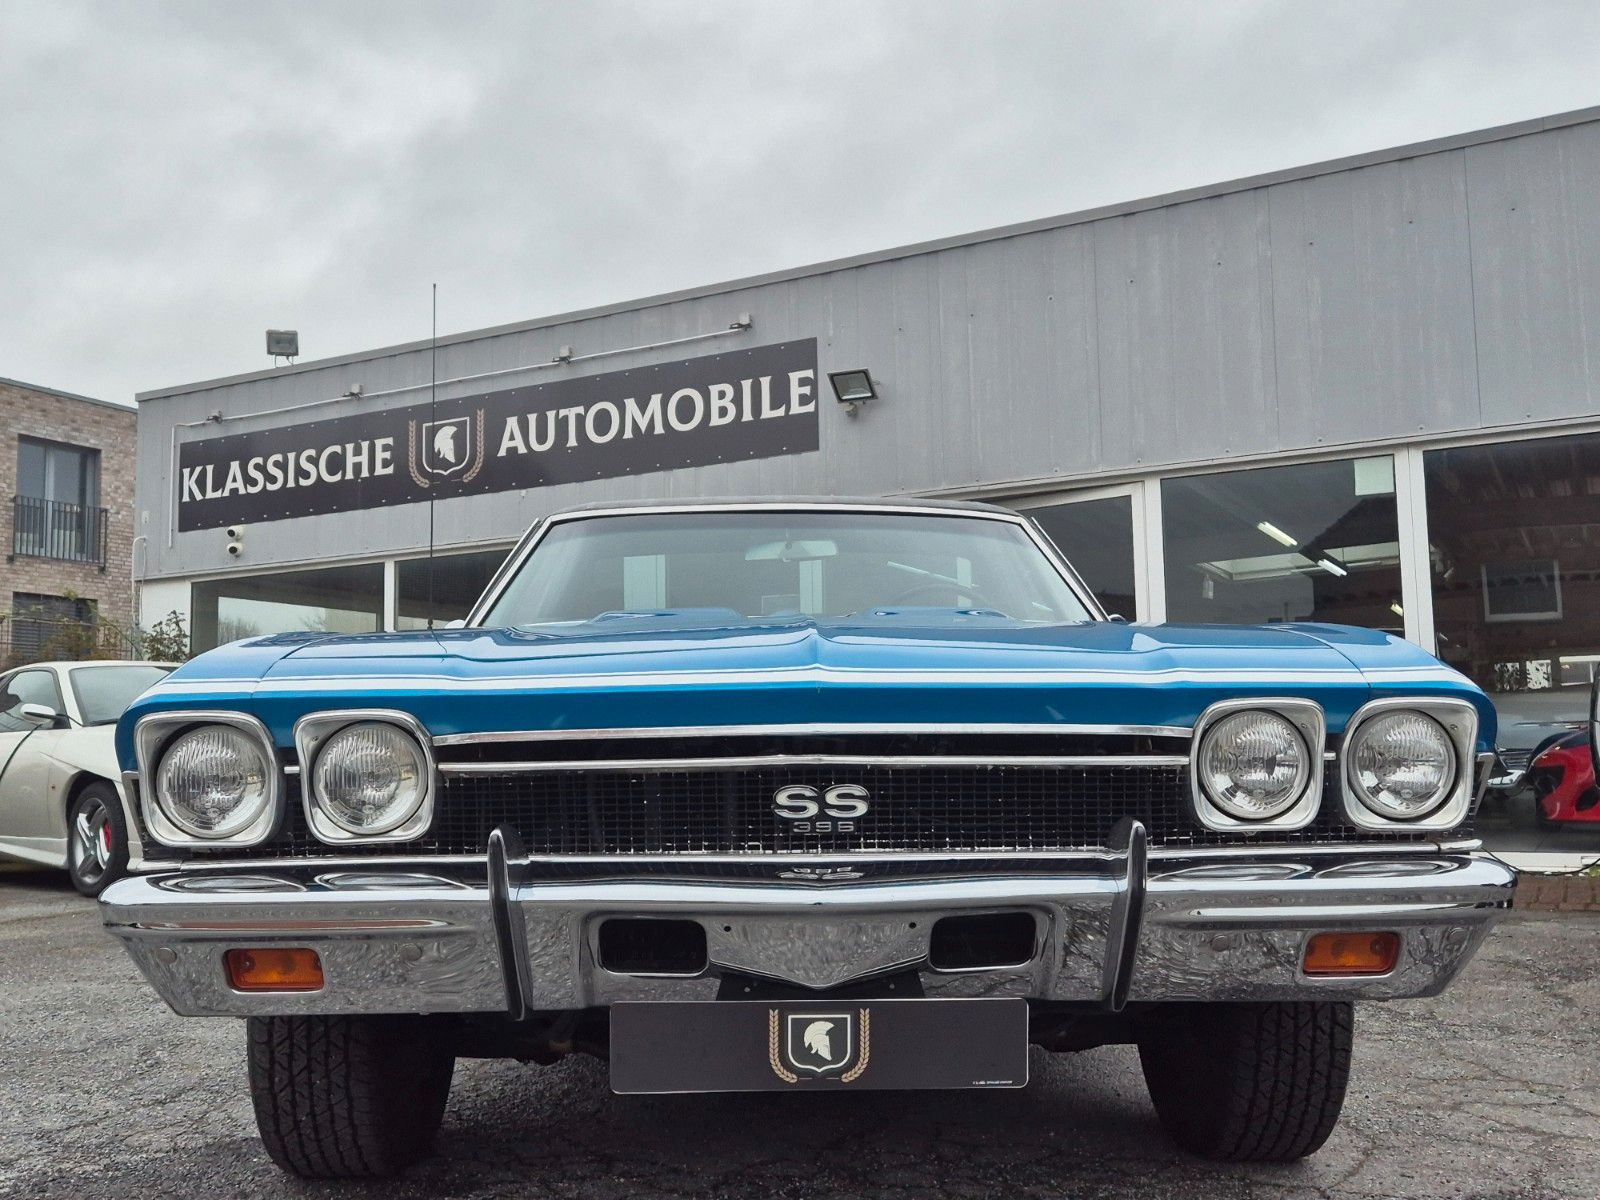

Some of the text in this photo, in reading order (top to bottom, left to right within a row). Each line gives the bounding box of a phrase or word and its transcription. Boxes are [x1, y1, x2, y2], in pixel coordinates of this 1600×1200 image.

[181, 369, 816, 502] KLASSISCHE AUTOMOBILE
[773, 784, 870, 819] SS
